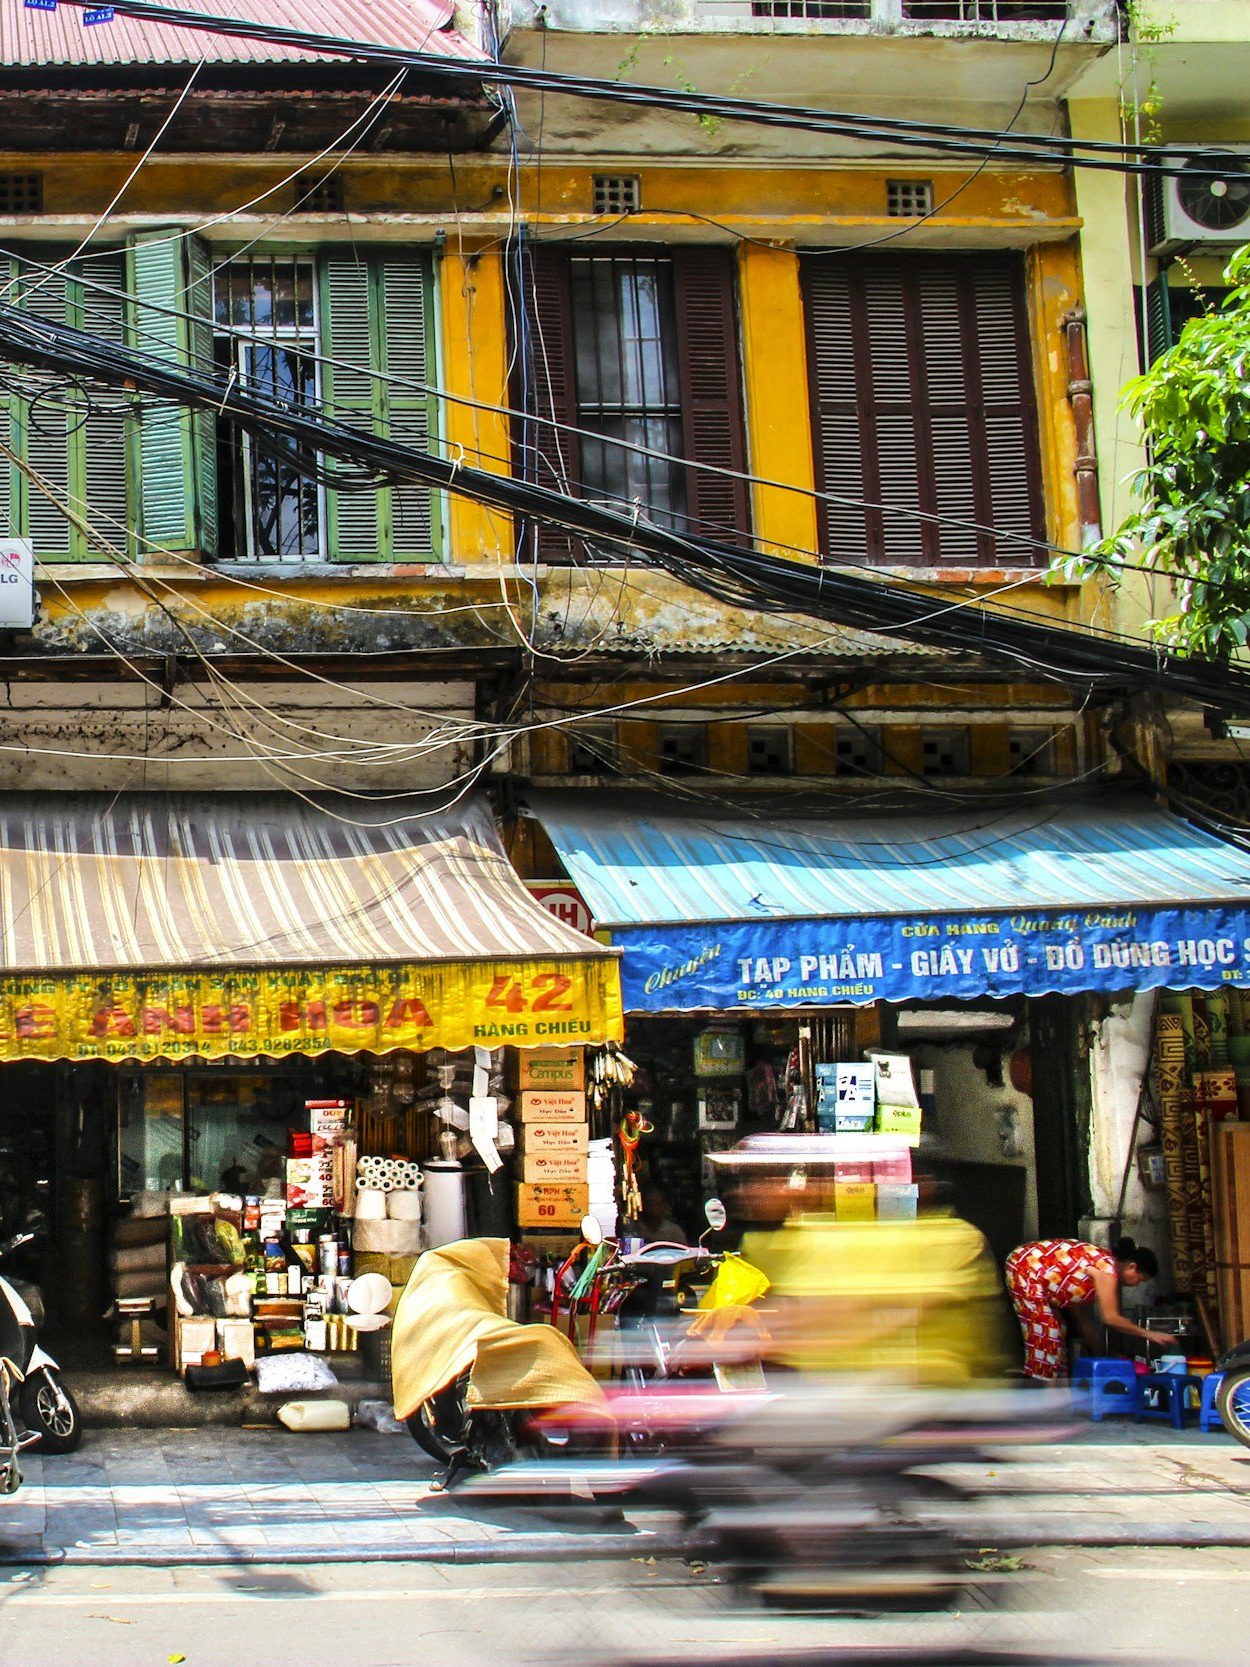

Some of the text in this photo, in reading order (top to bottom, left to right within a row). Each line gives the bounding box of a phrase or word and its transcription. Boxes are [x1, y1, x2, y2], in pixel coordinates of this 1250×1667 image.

[1, 574, 18, 583] LG
[737, 957, 791, 989] TẠP
[801, 944, 883, 981] PHẨM
[910, 940, 973, 977] GIẤY
[981, 938, 1020, 973] VỞ
[1045, 935, 1084, 971] ĐỒ
[1093, 937, 1171, 970] DÙNG
[1177, 938, 1235, 970] HỌC
[485, 973, 573, 1013] 42
[765, 988, 784, 999] 40
[832, 982, 874, 996] CHIẾU
[88, 1002, 249, 1038] ANH
[279, 998, 435, 1032] HOA
[474, 1017, 591, 1037] HÀNG CHIẾU
[530, 1067, 573, 1081] Campus
[538, 1205, 555, 1216] 60
